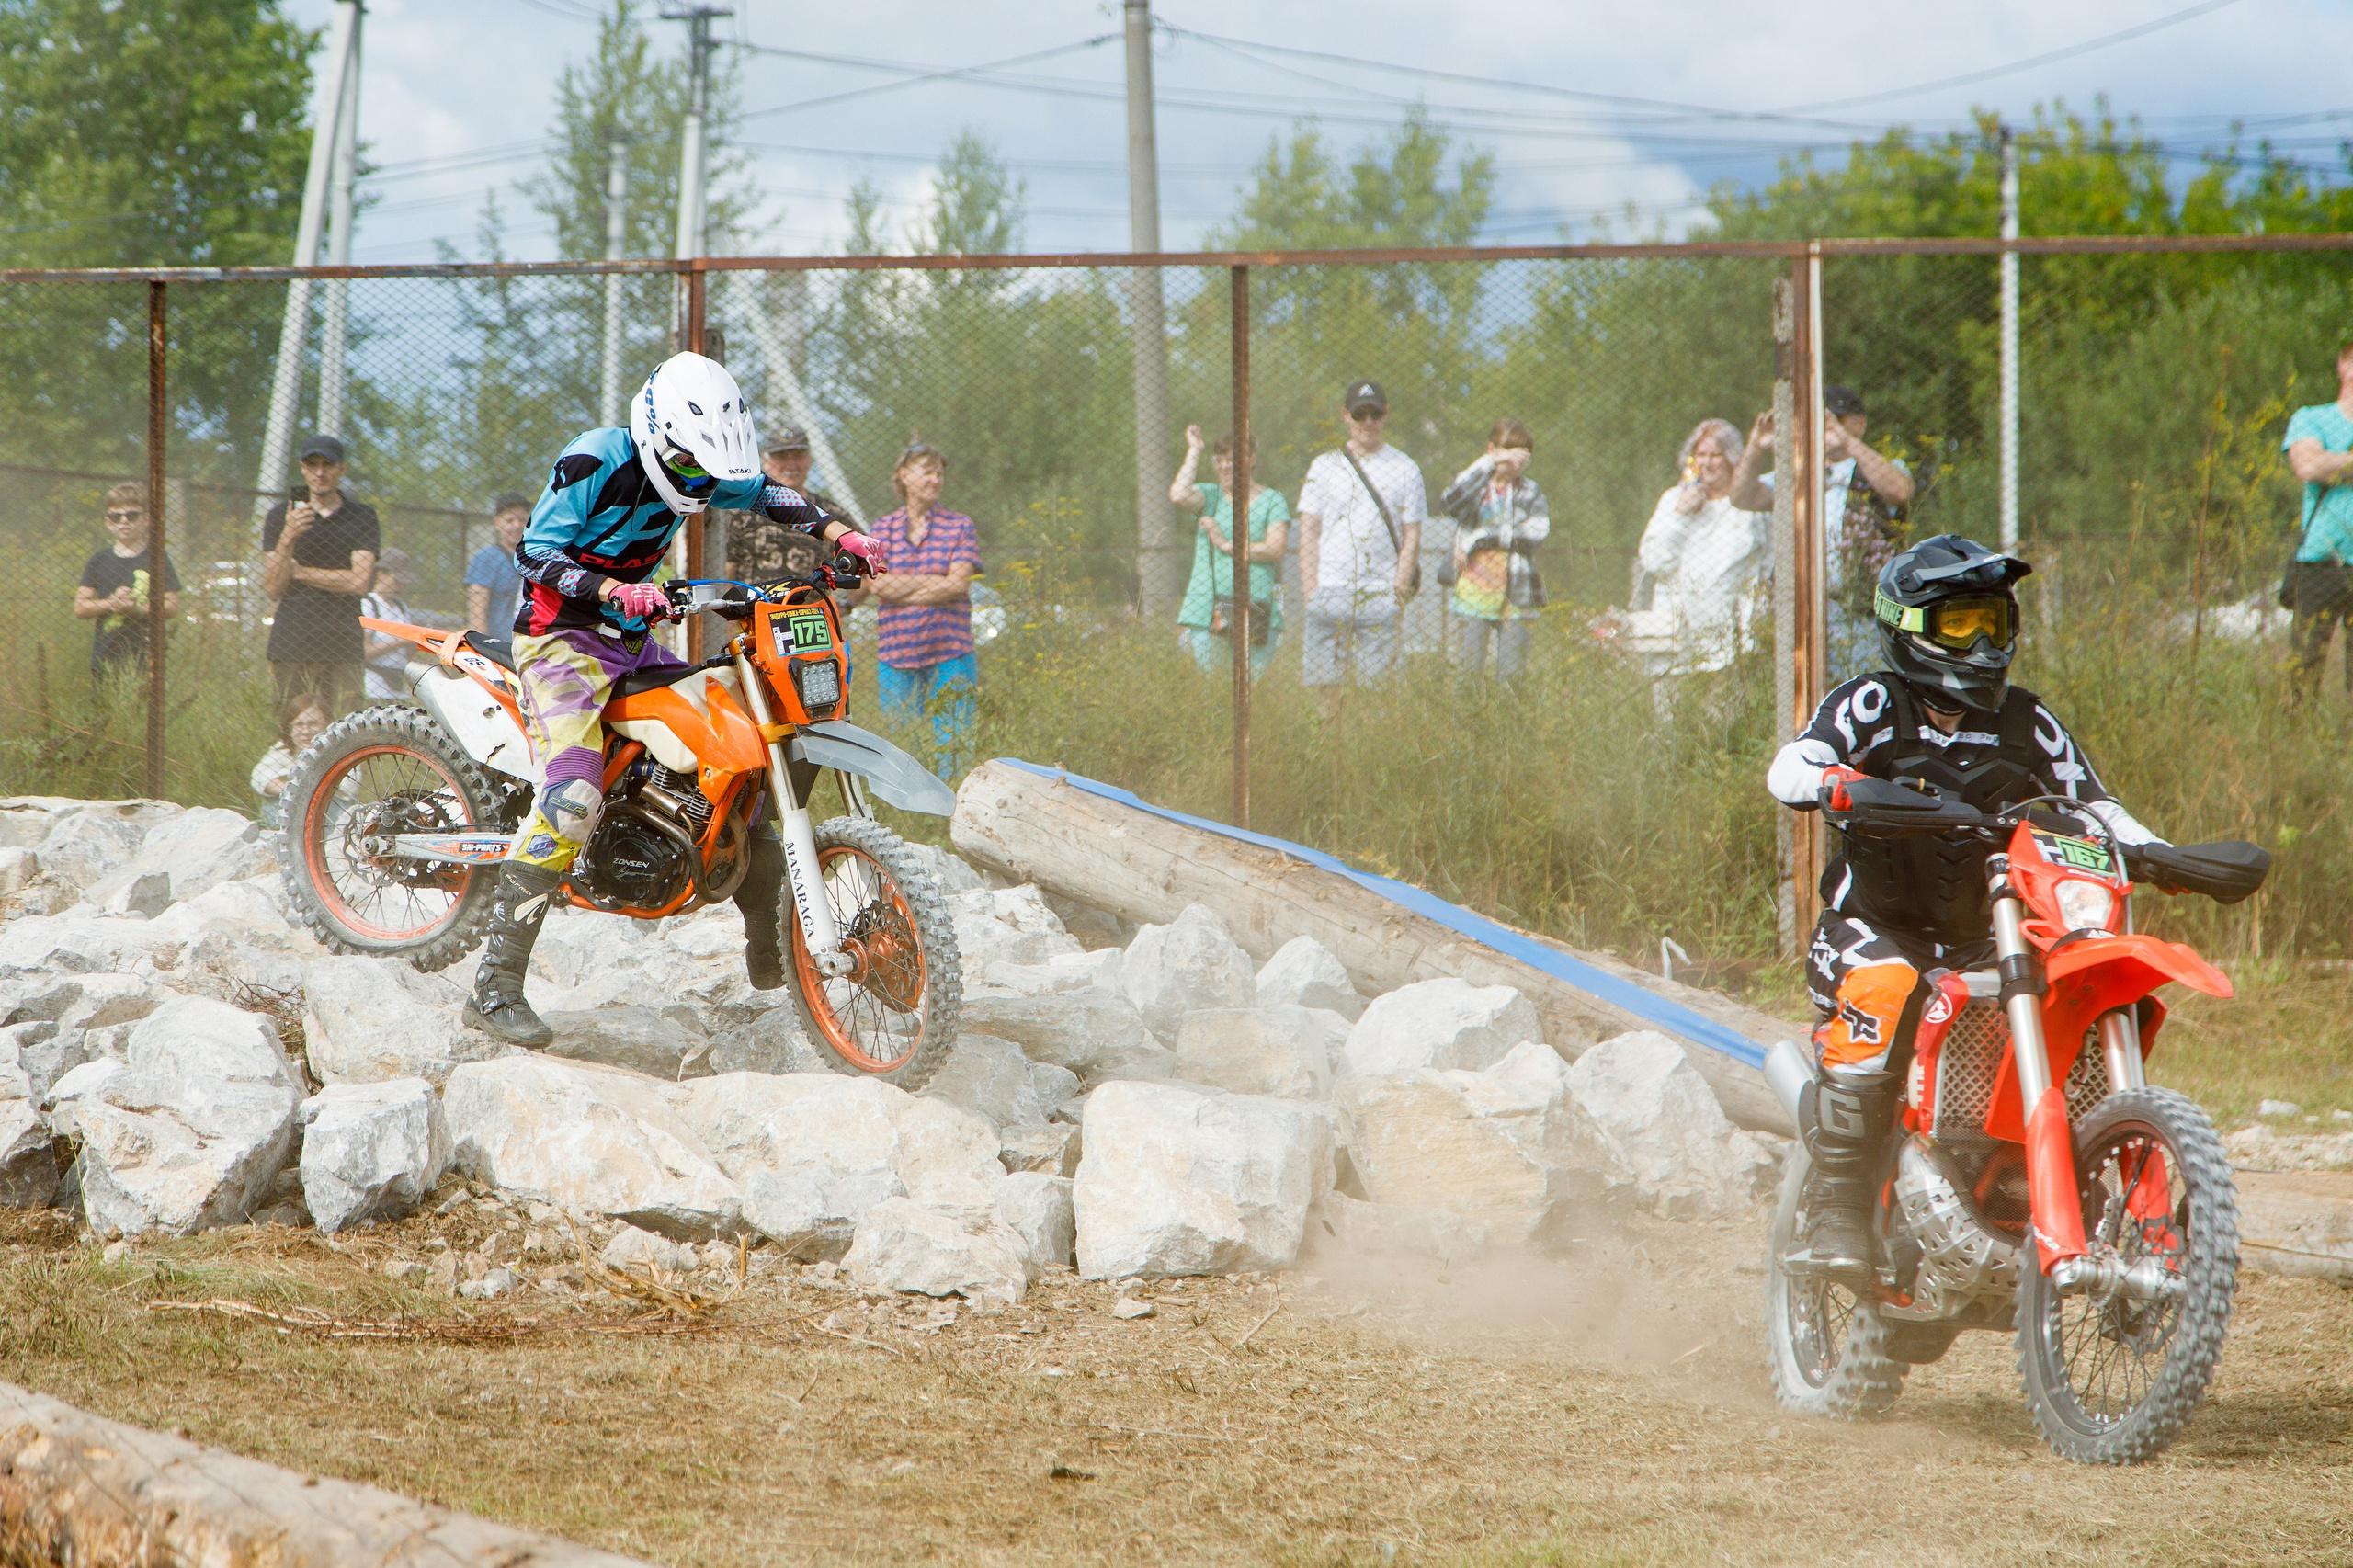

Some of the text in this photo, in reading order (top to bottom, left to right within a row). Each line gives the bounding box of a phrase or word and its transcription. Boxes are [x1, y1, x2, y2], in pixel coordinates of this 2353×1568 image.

[794, 620, 828, 645] 175
[461, 843, 502, 852] SM-PARTS
[2062, 843, 2109, 870] 167
[612, 857, 651, 869] ZONSEN
[785, 842, 815, 939] MANARAGA
